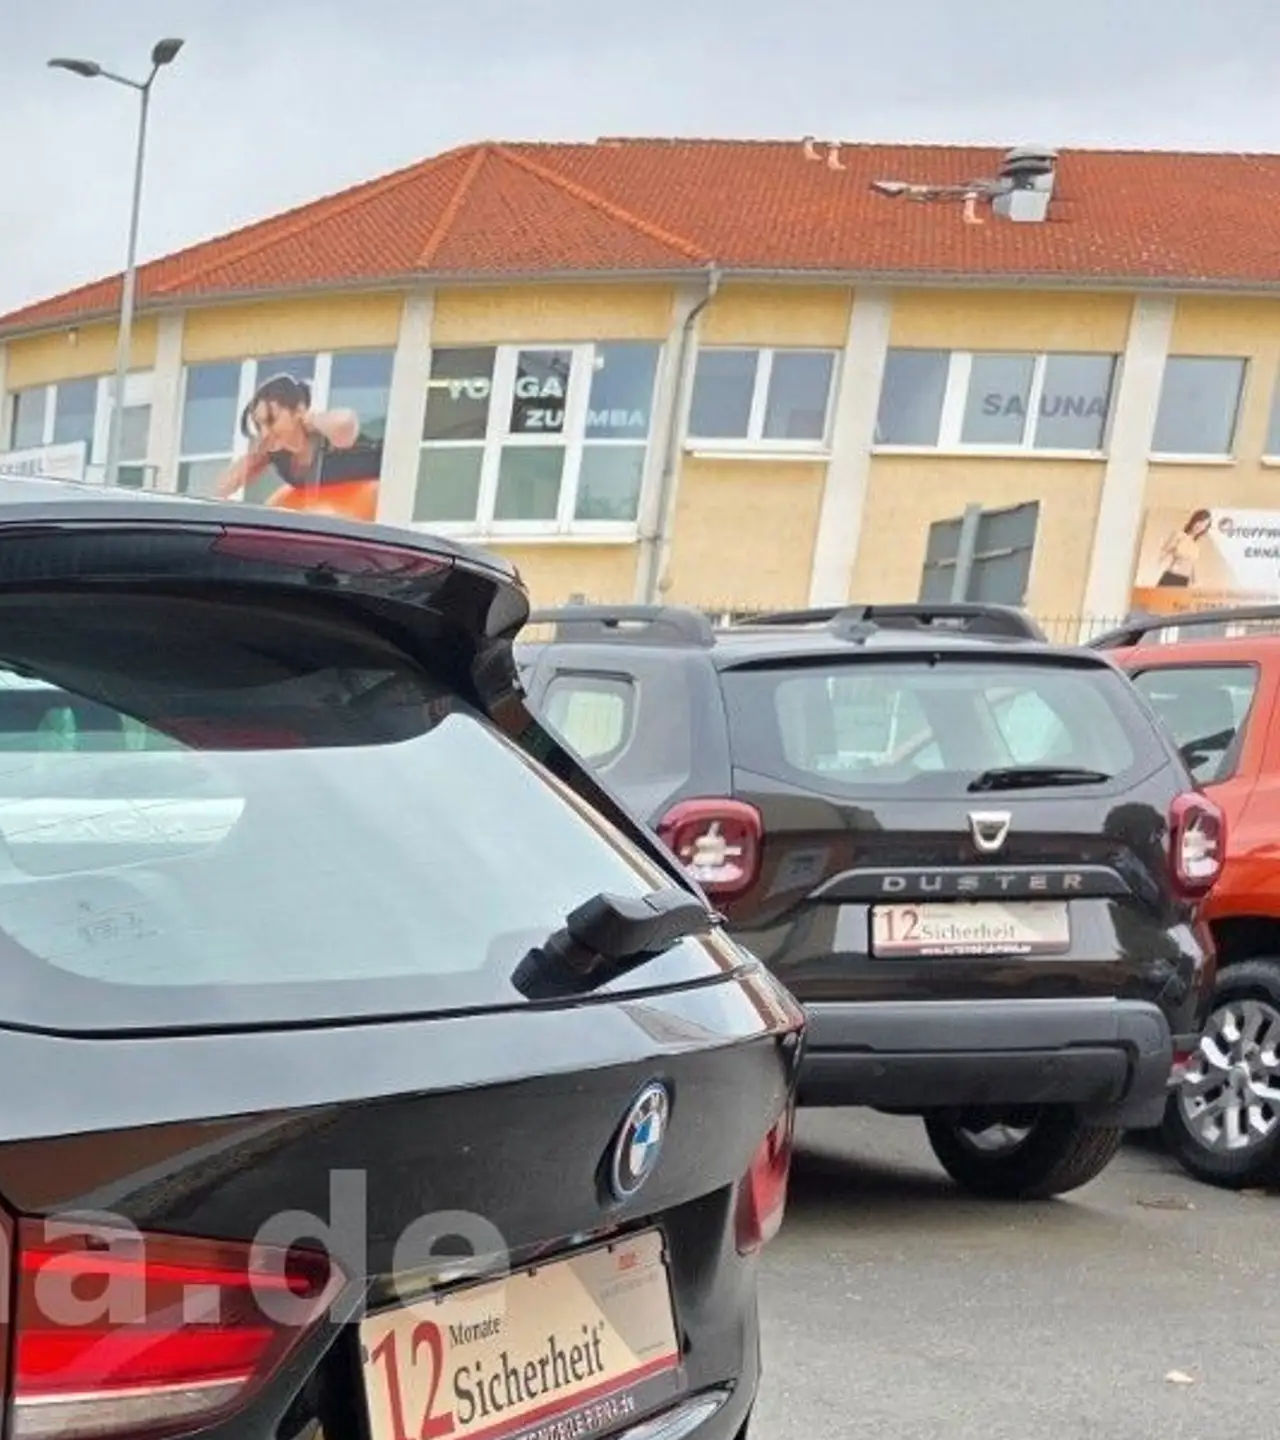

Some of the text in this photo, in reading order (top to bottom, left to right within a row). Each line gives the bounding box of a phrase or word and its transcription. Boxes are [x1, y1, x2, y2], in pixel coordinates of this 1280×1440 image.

[982, 392, 1106, 417] SAUNA
[882, 875, 1083, 891] DUSTER
[883, 910, 920, 941] 12
[449, 1314, 501, 1348] Monate
